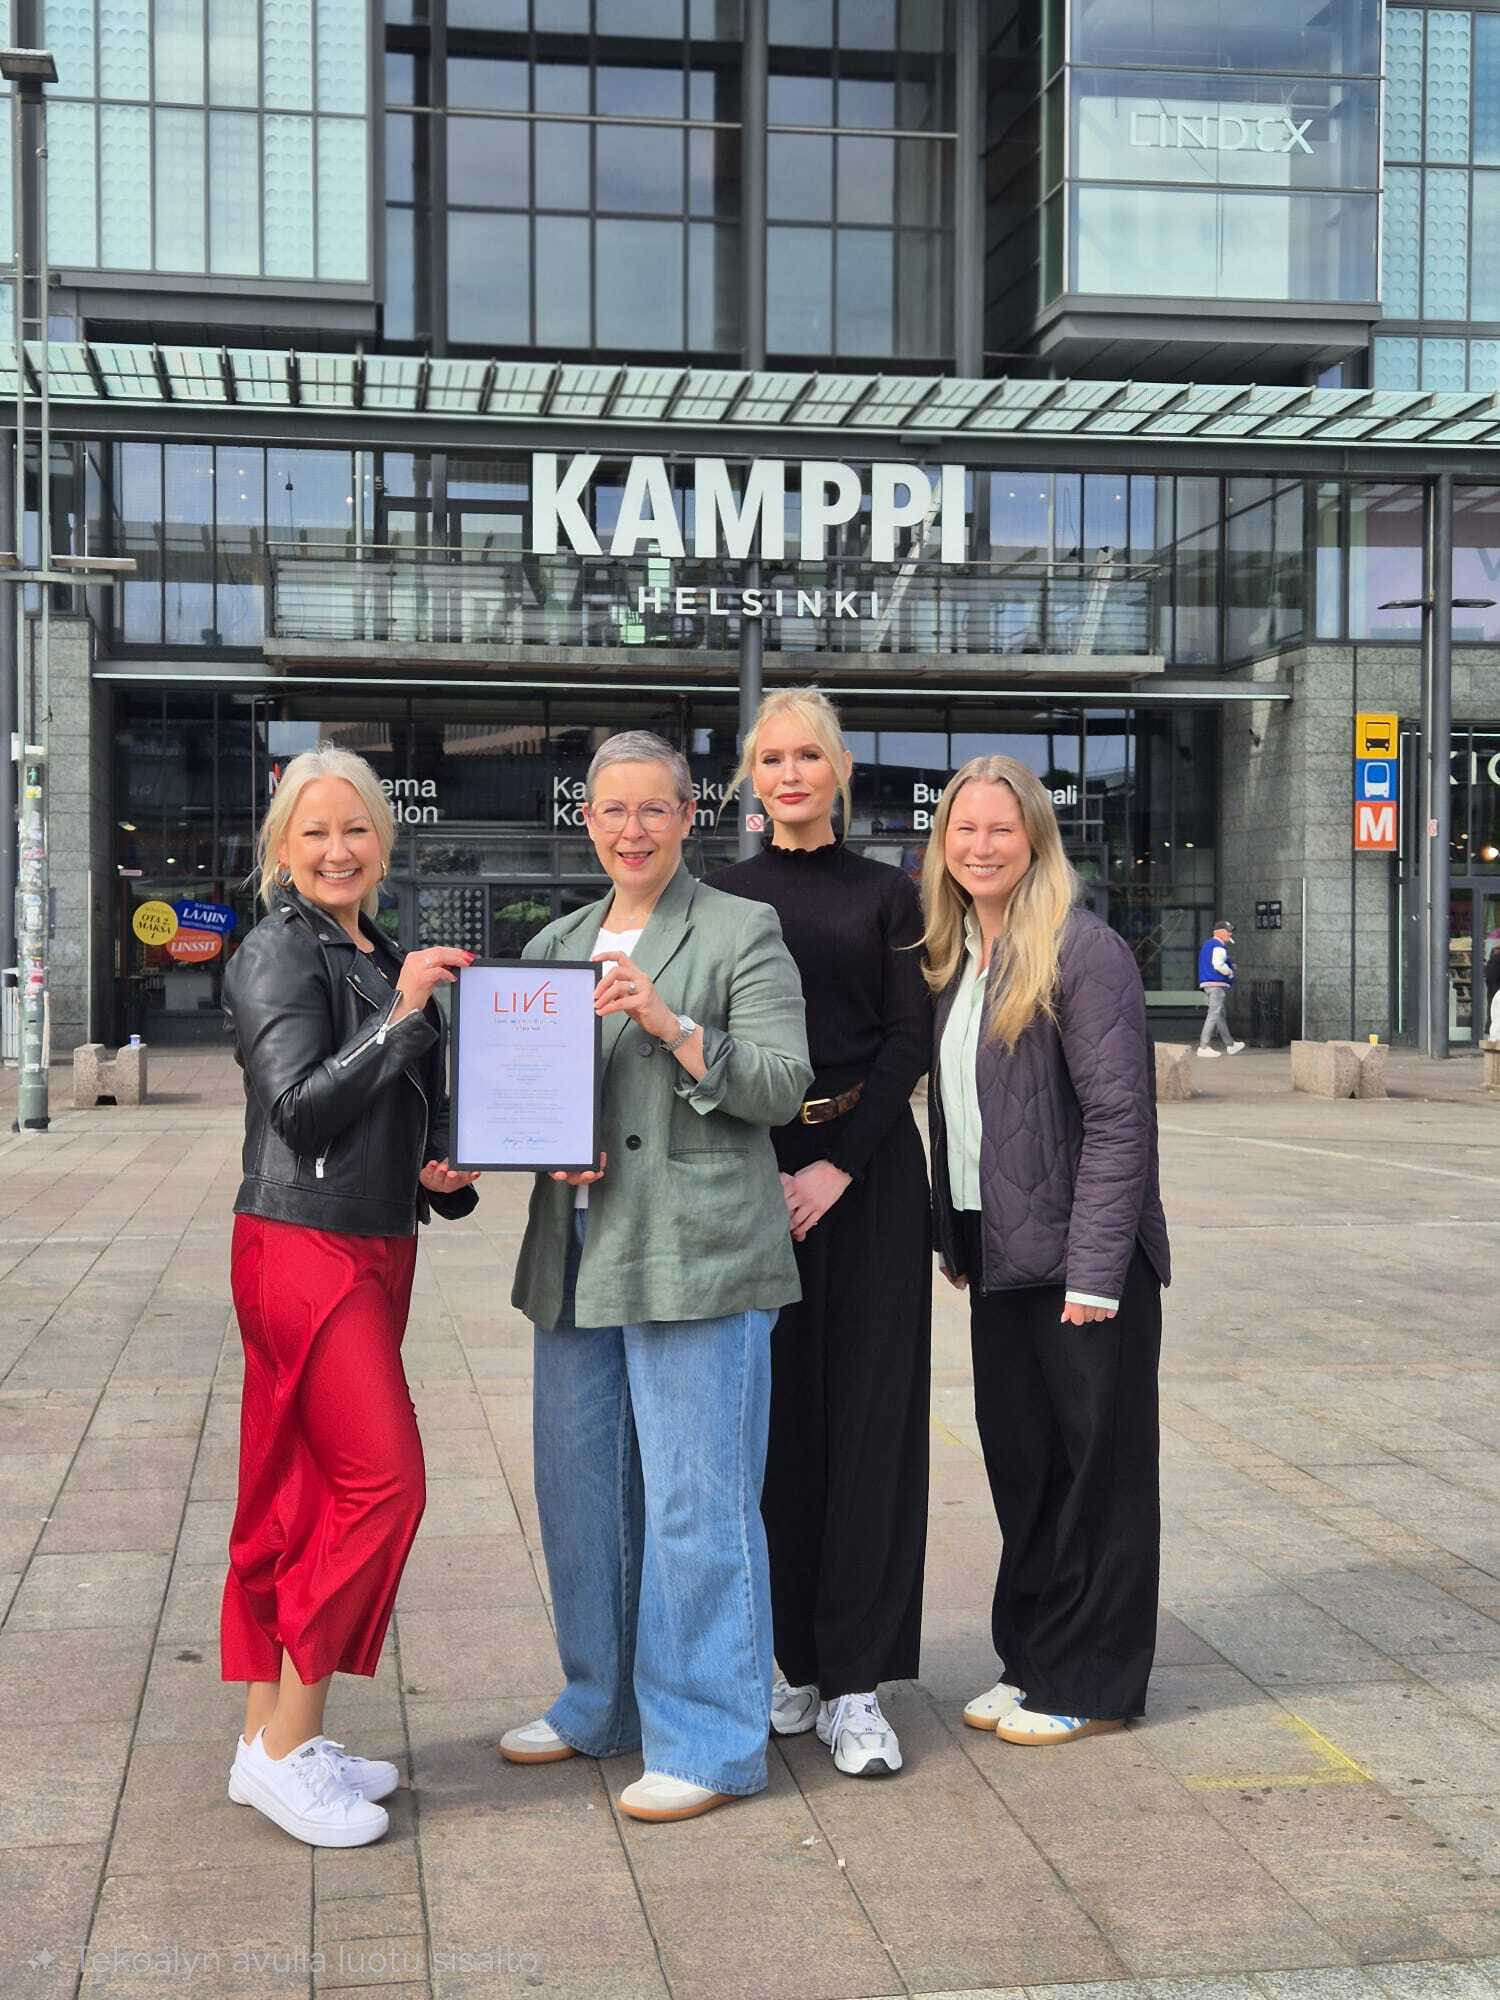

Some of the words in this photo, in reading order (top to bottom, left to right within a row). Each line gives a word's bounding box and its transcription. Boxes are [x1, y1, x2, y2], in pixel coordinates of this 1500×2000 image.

[1130, 112, 1314, 154] LINDEX
[532, 452, 966, 564] KAMPPI
[638, 586, 879, 619] HELSINKI
[1360, 807, 1393, 842] M
[494, 981, 558, 1013] LIVE
